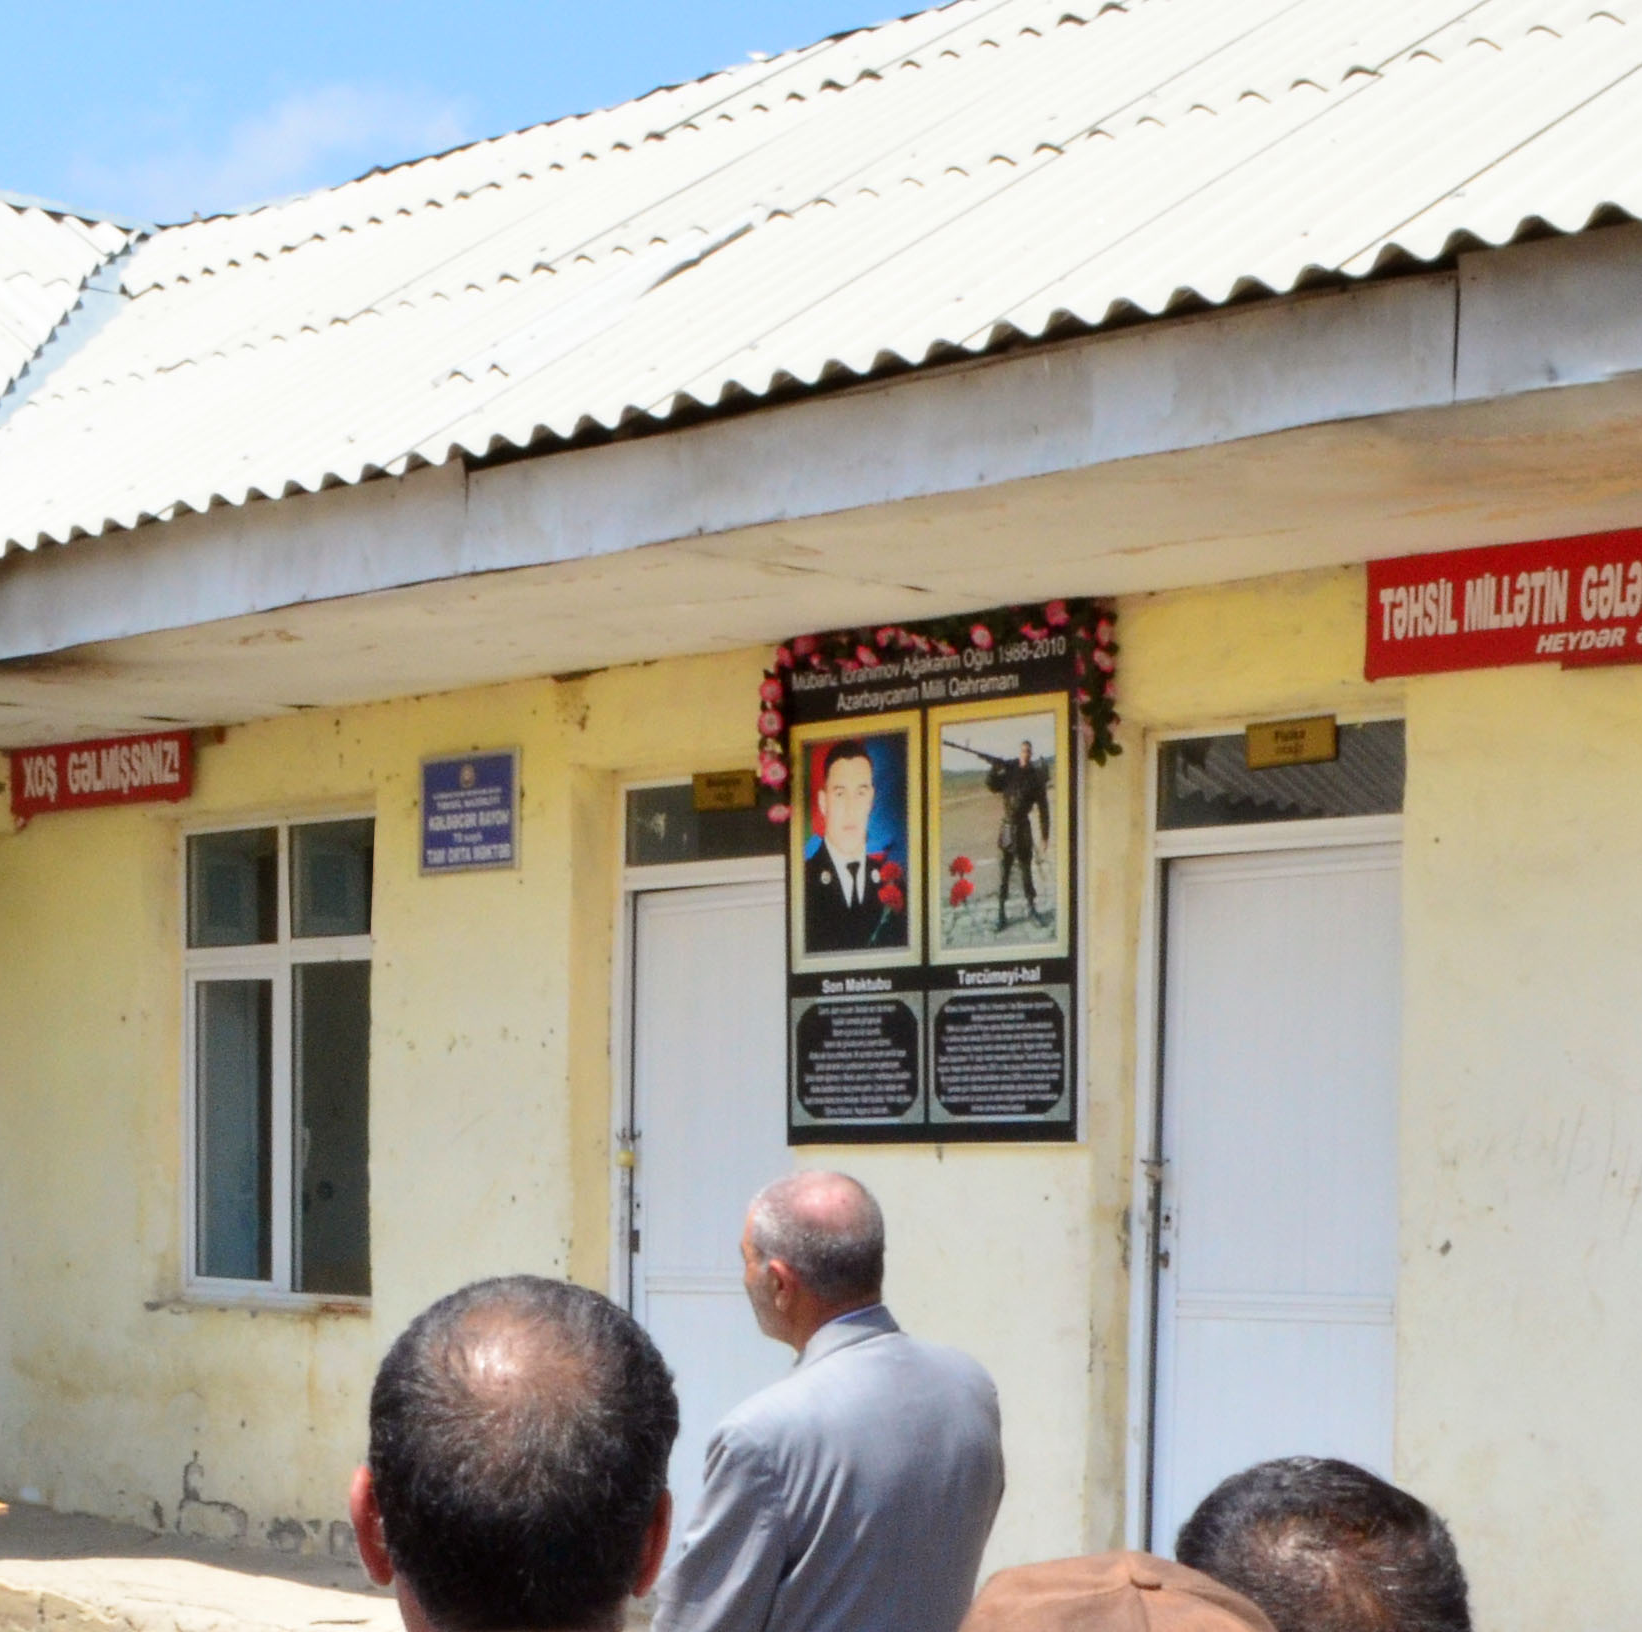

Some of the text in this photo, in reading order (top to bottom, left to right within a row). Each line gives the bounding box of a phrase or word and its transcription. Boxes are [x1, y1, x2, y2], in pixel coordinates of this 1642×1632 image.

[1379, 577, 1458, 641] TƏHSİL
[1463, 565, 1570, 633] MİLLƏTİN
[1535, 627, 1626, 655] HEYDƏR
[22, 753, 58, 803] XOŞ
